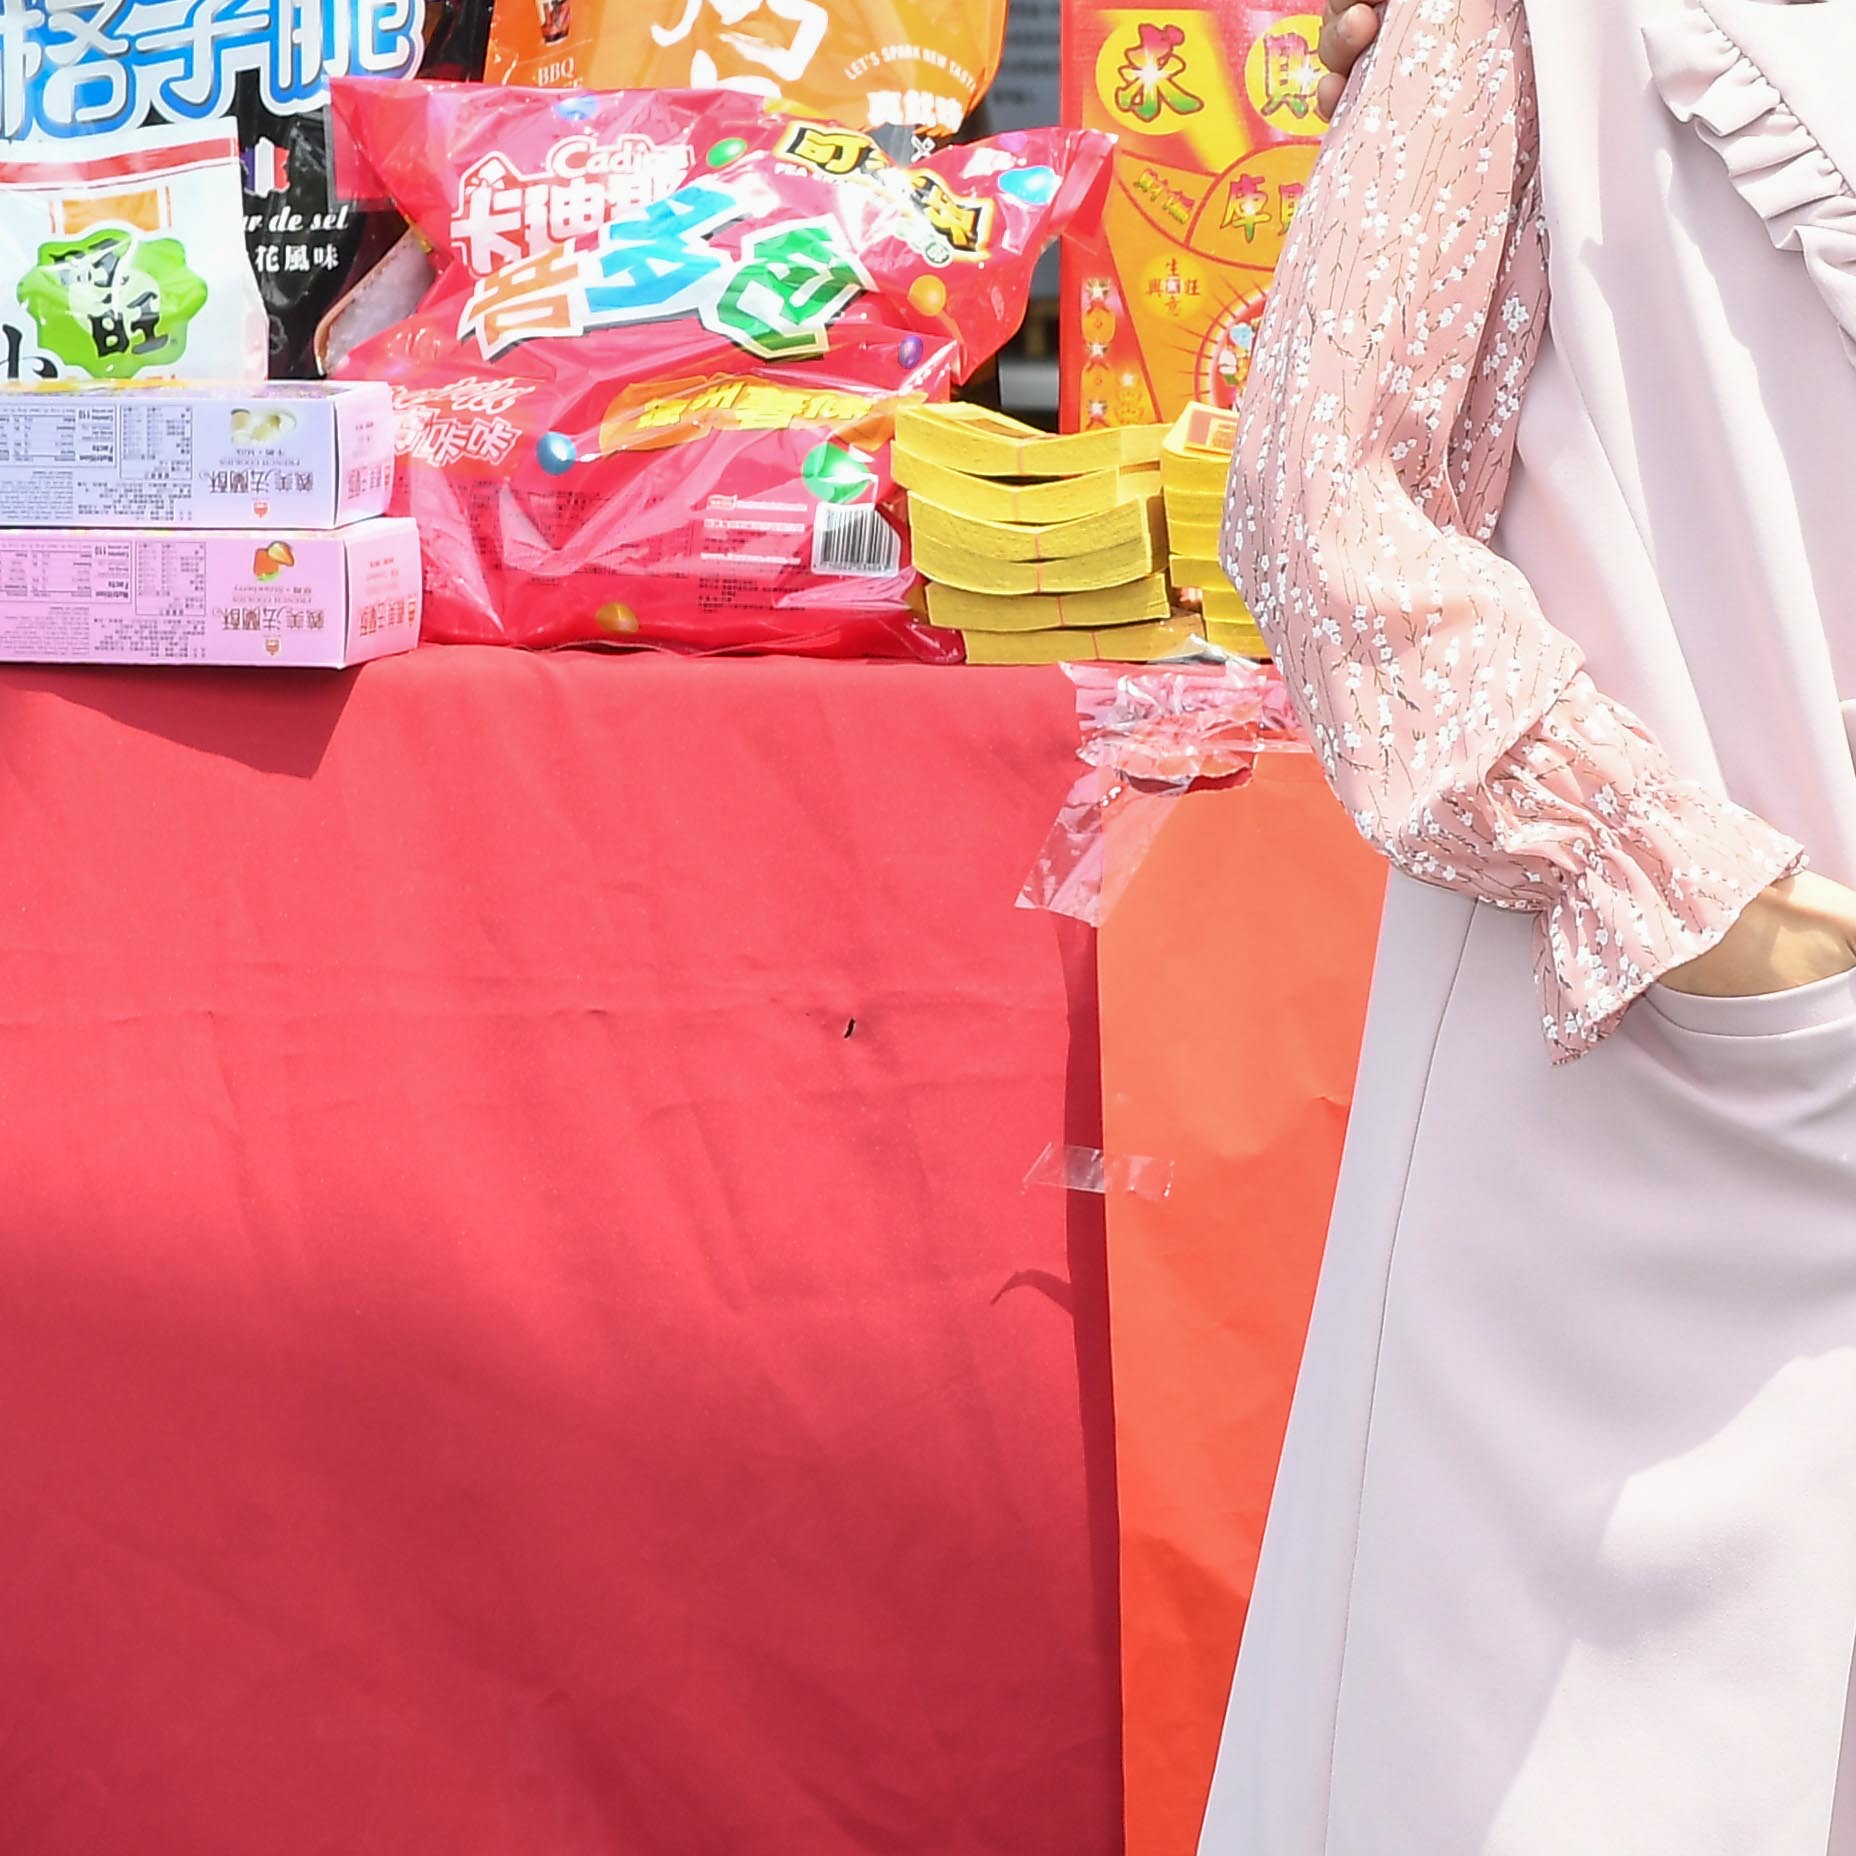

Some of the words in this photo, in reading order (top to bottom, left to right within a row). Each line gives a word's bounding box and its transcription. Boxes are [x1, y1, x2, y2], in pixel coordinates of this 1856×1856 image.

[537, 57, 575, 86] BBQ
[949, 61, 977, 92] TAST
[553, 140, 690, 180] Cadi
[268, 206, 304, 231] de
[310, 205, 349, 231] sel
[254, 243, 339, 273] 花風味
